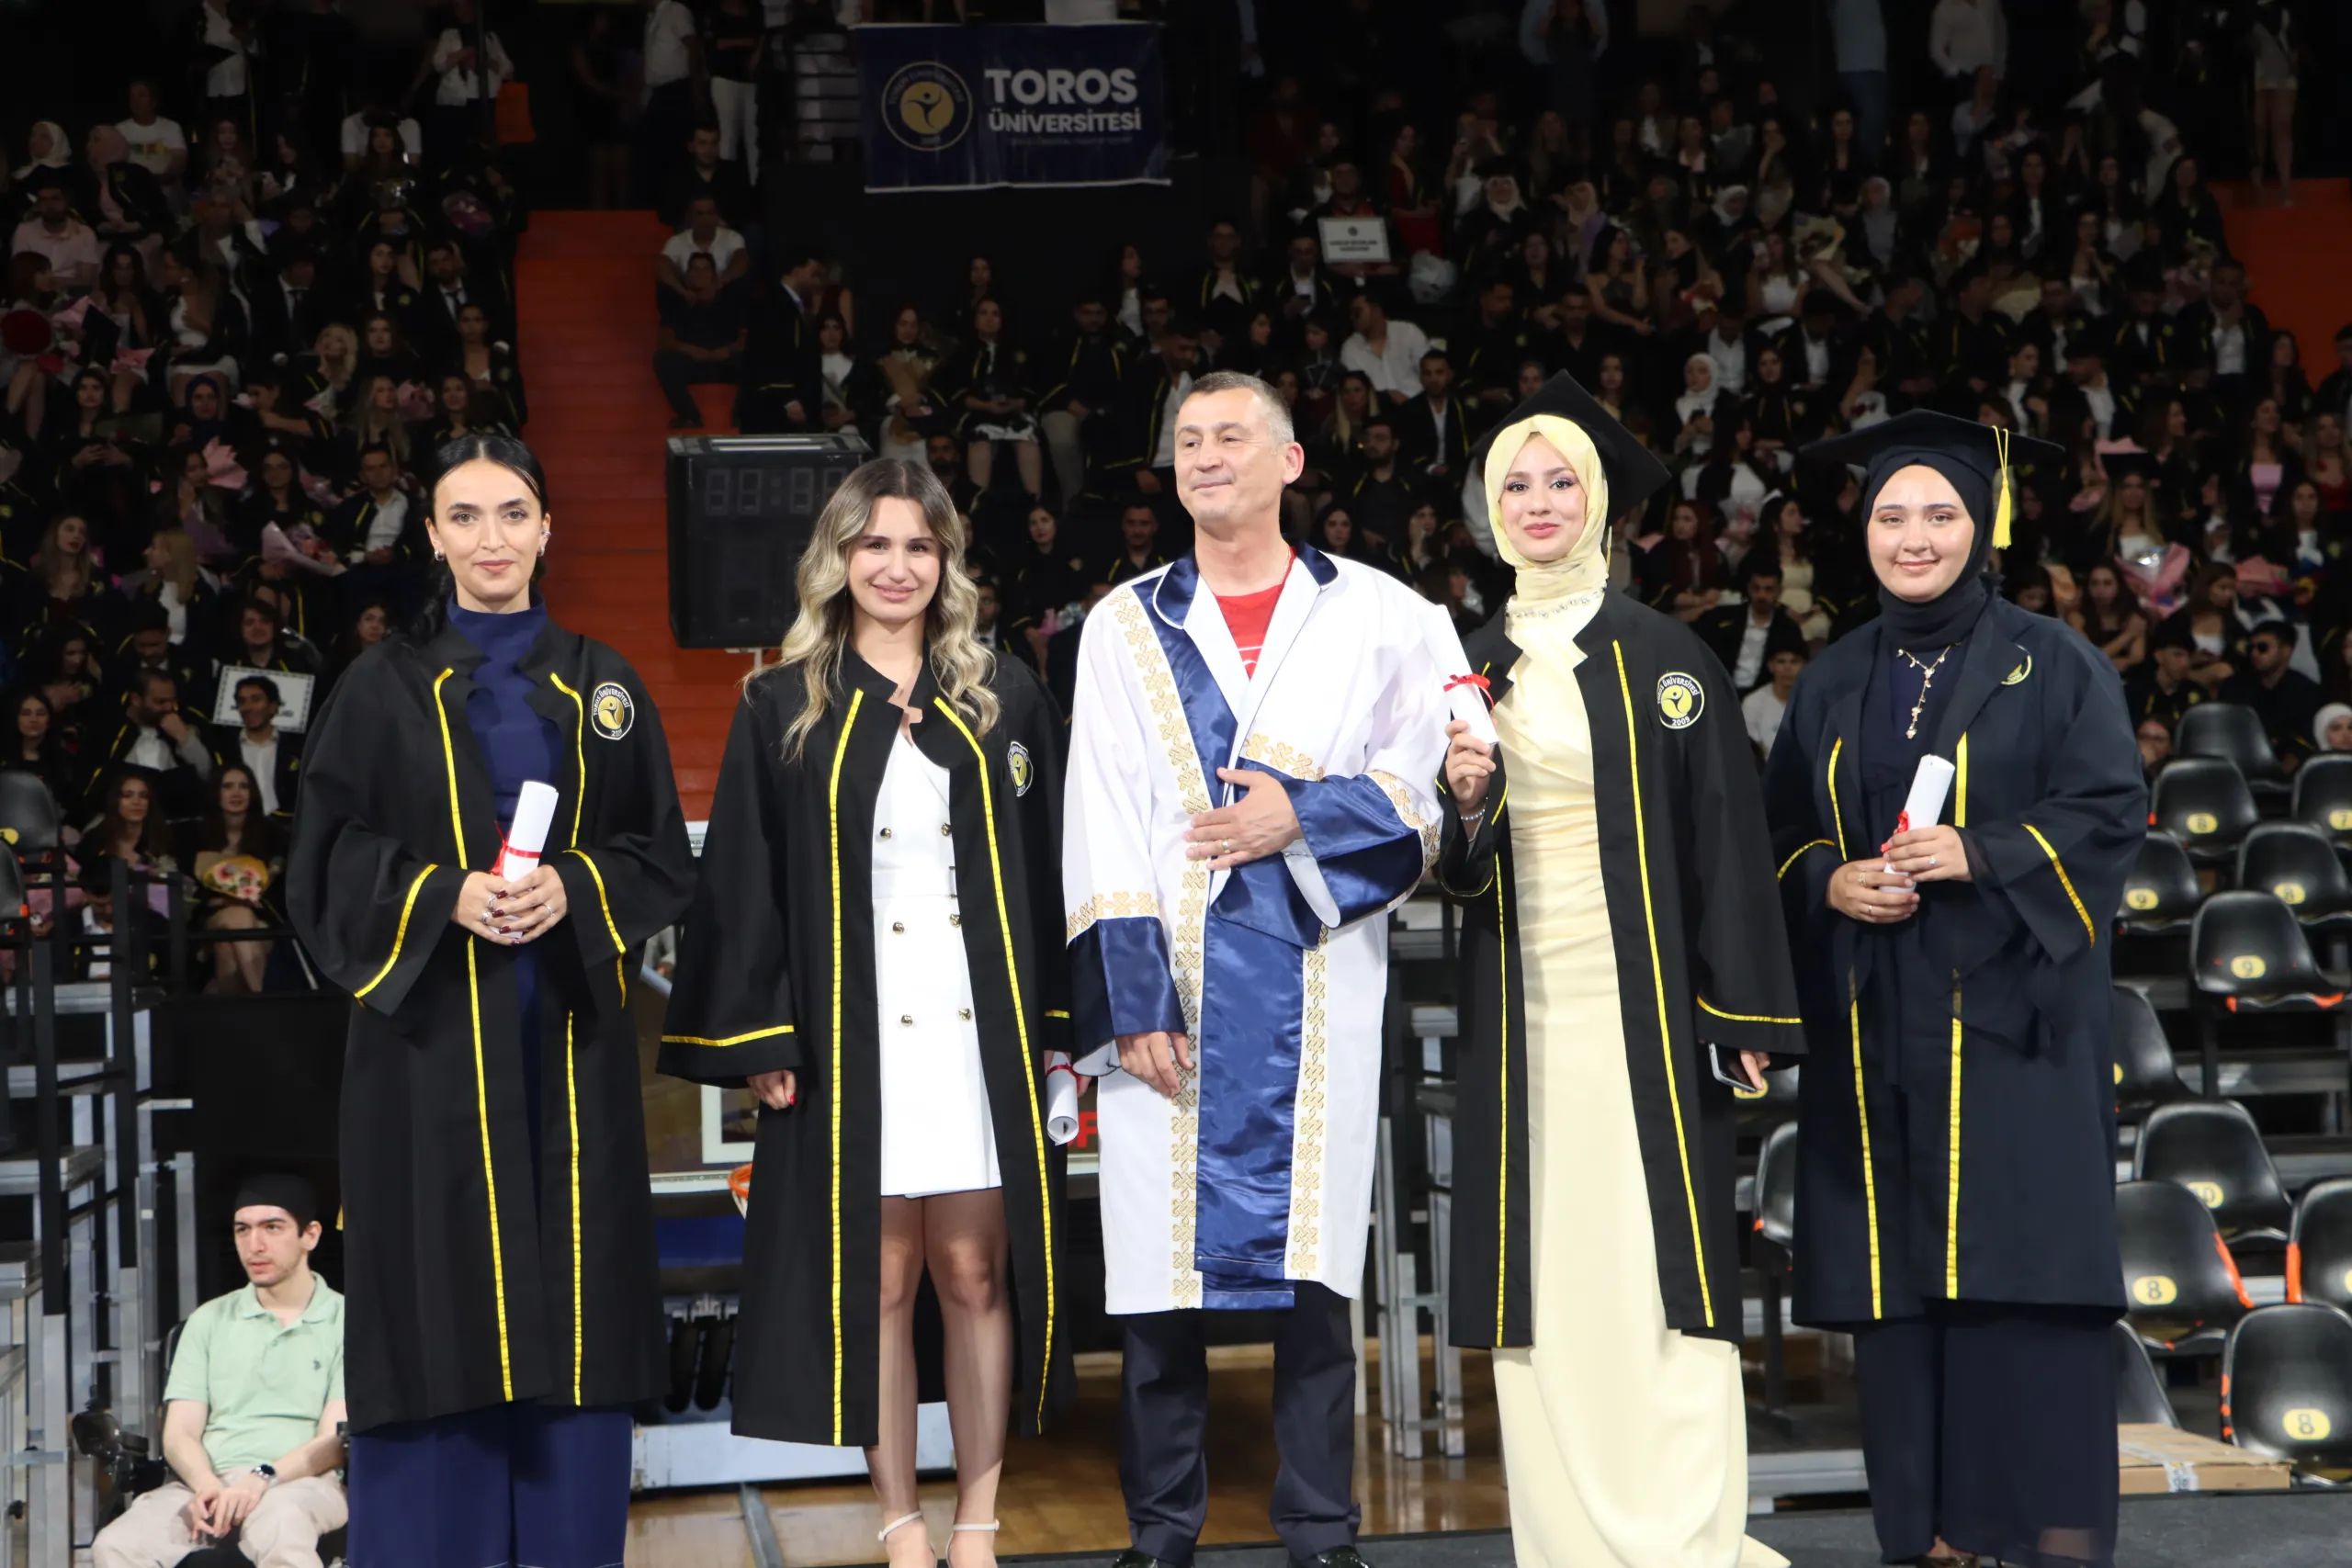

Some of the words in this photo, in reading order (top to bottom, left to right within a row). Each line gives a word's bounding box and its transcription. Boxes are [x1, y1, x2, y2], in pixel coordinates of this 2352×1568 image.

[984, 67, 1138, 106] TOROS
[988, 107, 1142, 133] ÜNİVERSİTESİ
[1662, 676, 1701, 695] ÜNİVERSİTESİ
[599, 687, 630, 708] ÜNİVERSİTESİ
[1671, 716, 1690, 726] 2009
[2147, 1280, 2163, 1300] 8
[2298, 1413, 2315, 1436] 8
